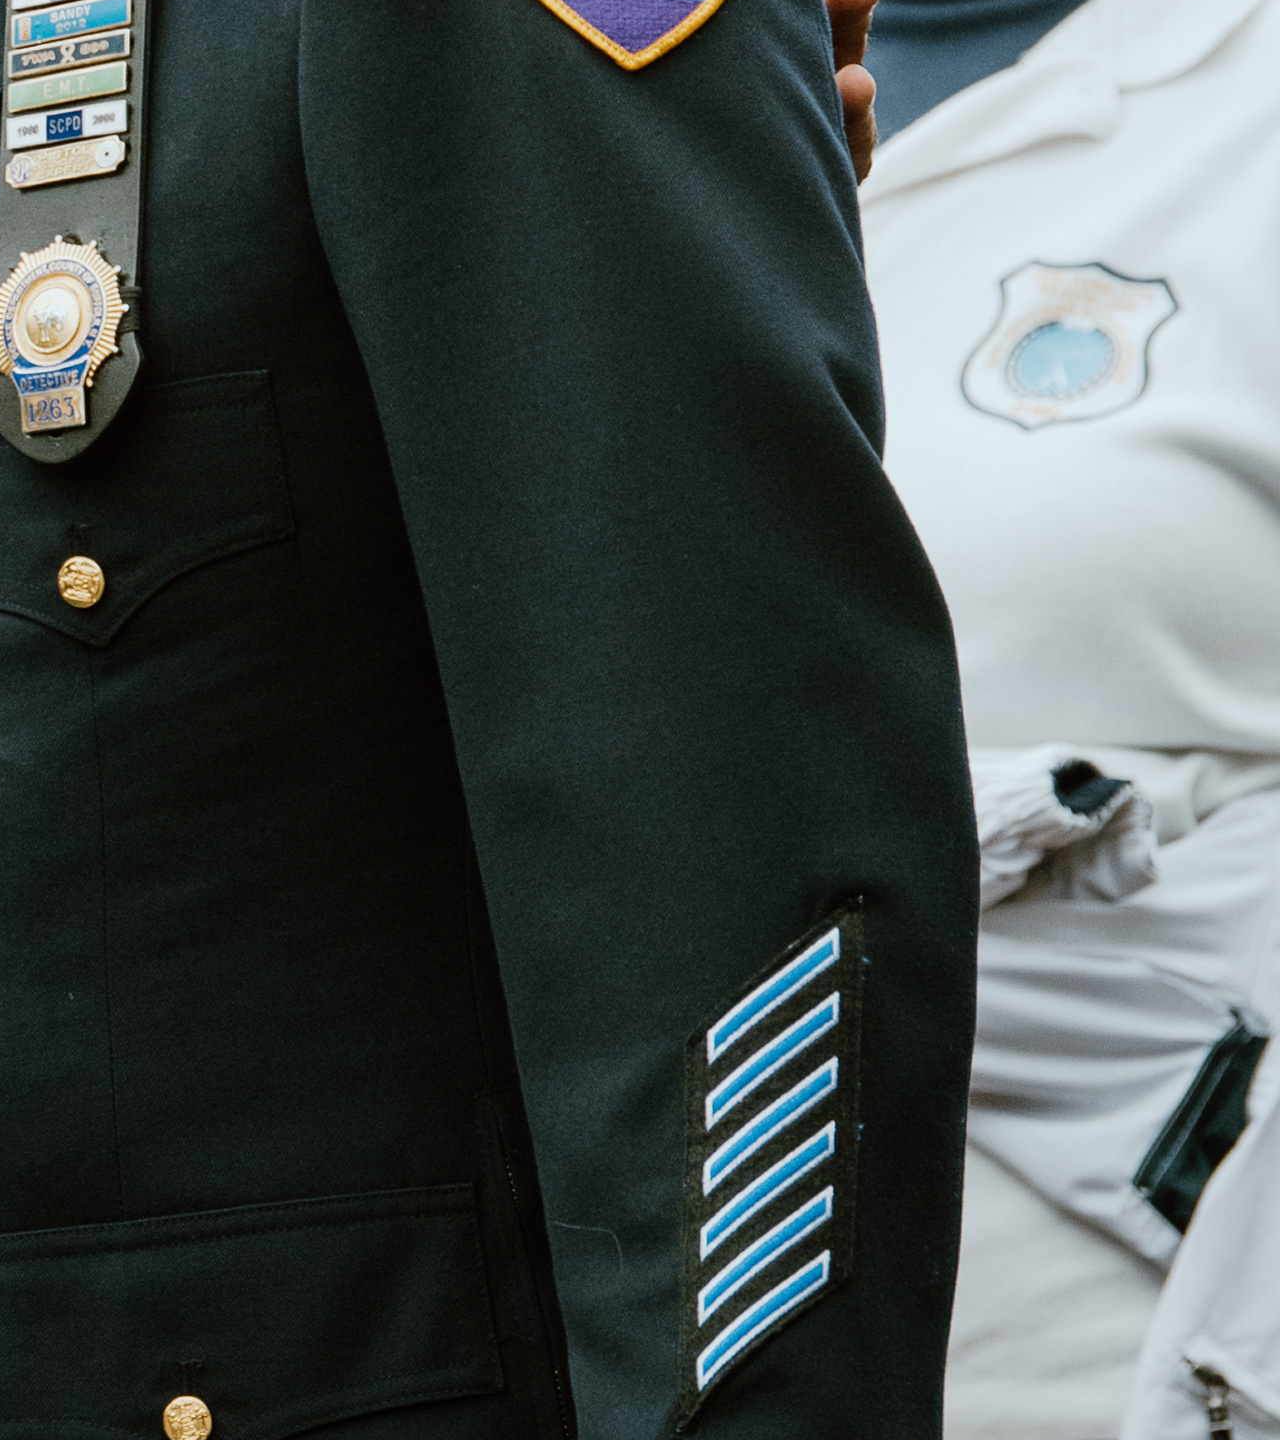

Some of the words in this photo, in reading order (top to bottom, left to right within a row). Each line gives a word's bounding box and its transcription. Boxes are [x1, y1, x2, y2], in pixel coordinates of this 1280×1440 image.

[49, 5, 92, 24] SANDY
[55, 18, 87, 34] 2012
[49, 115, 81, 135] SCPD
[20, 369, 79, 391] DETECTIVE
[29, 396, 75, 423] 1263
